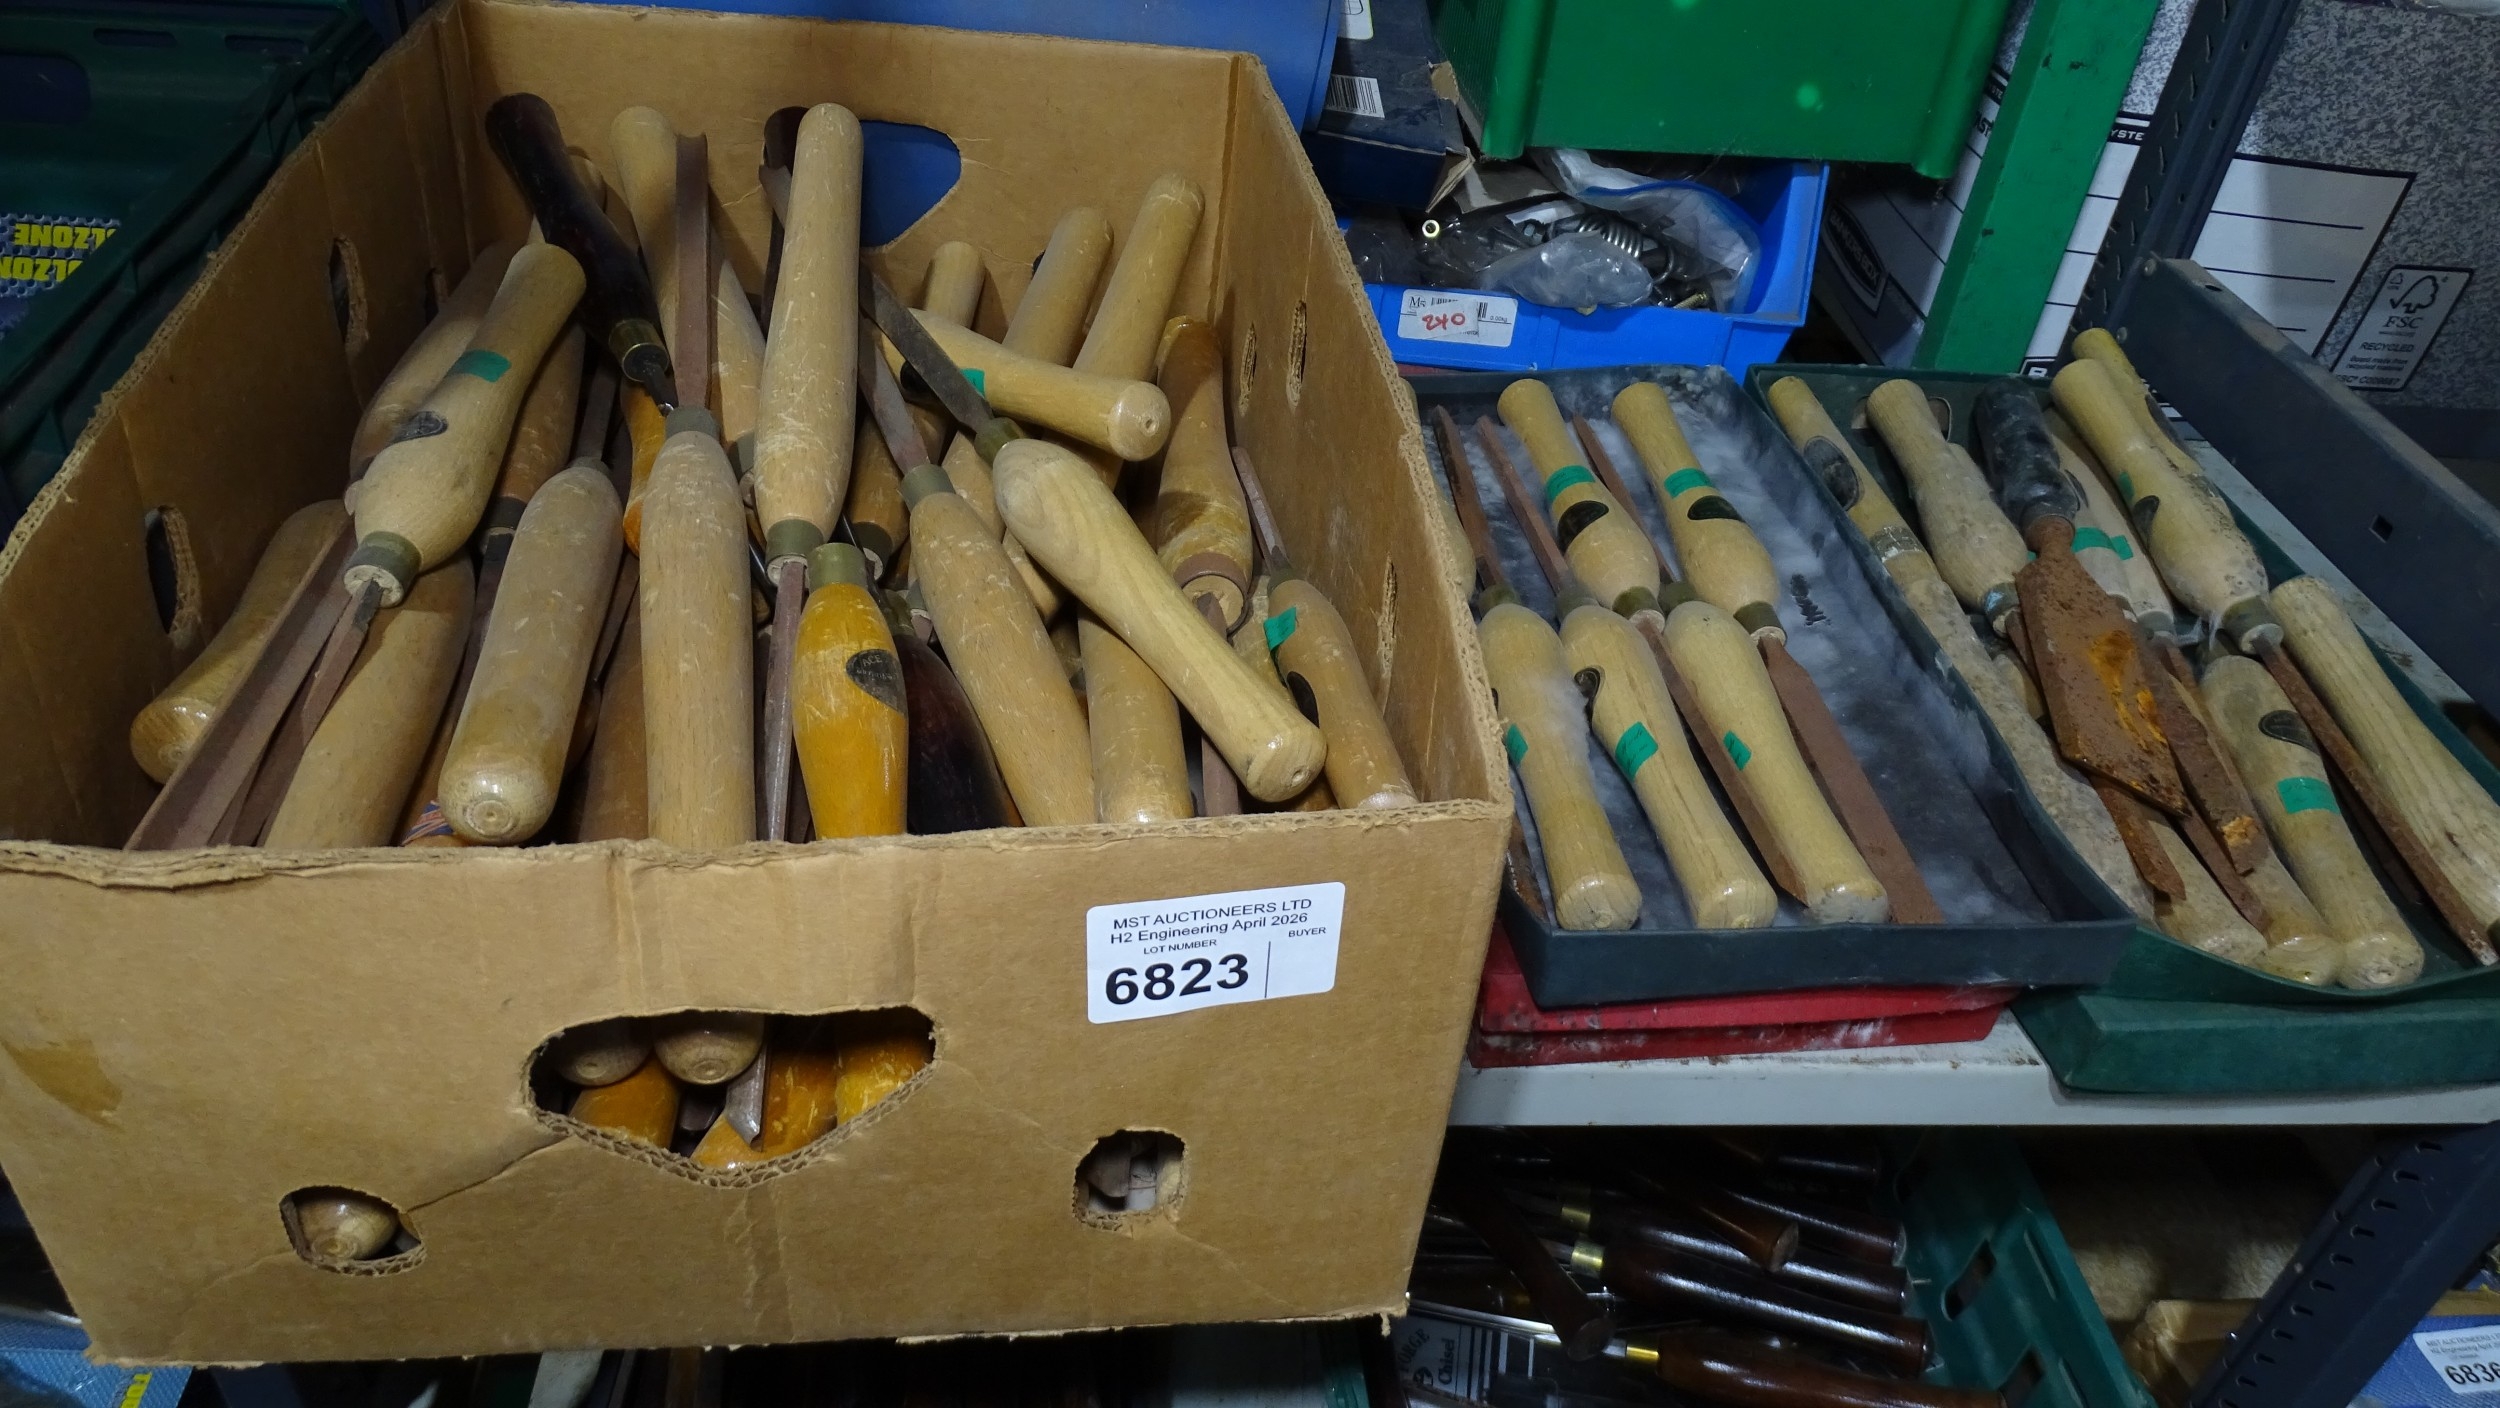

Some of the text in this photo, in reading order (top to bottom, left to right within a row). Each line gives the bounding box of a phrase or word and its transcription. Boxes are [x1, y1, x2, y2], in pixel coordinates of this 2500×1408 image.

[14, 223, 117, 250] LZONE
[2383, 315, 2425, 329] FSC
[2360, 341, 2415, 353] RECYCLED
[1113, 898, 1312, 930] MST AUCTIONEERS LTD
[1110, 912, 1308, 944] H2 Engineering April 2026
[1288, 926, 1327, 938] BUYER
[1143, 938, 1218, 955] LOT NUMBER
[1105, 953, 1249, 1006] 6823
[1437, 1338, 1456, 1385] Chisel
[2444, 1361, 2500, 1385] 6836
